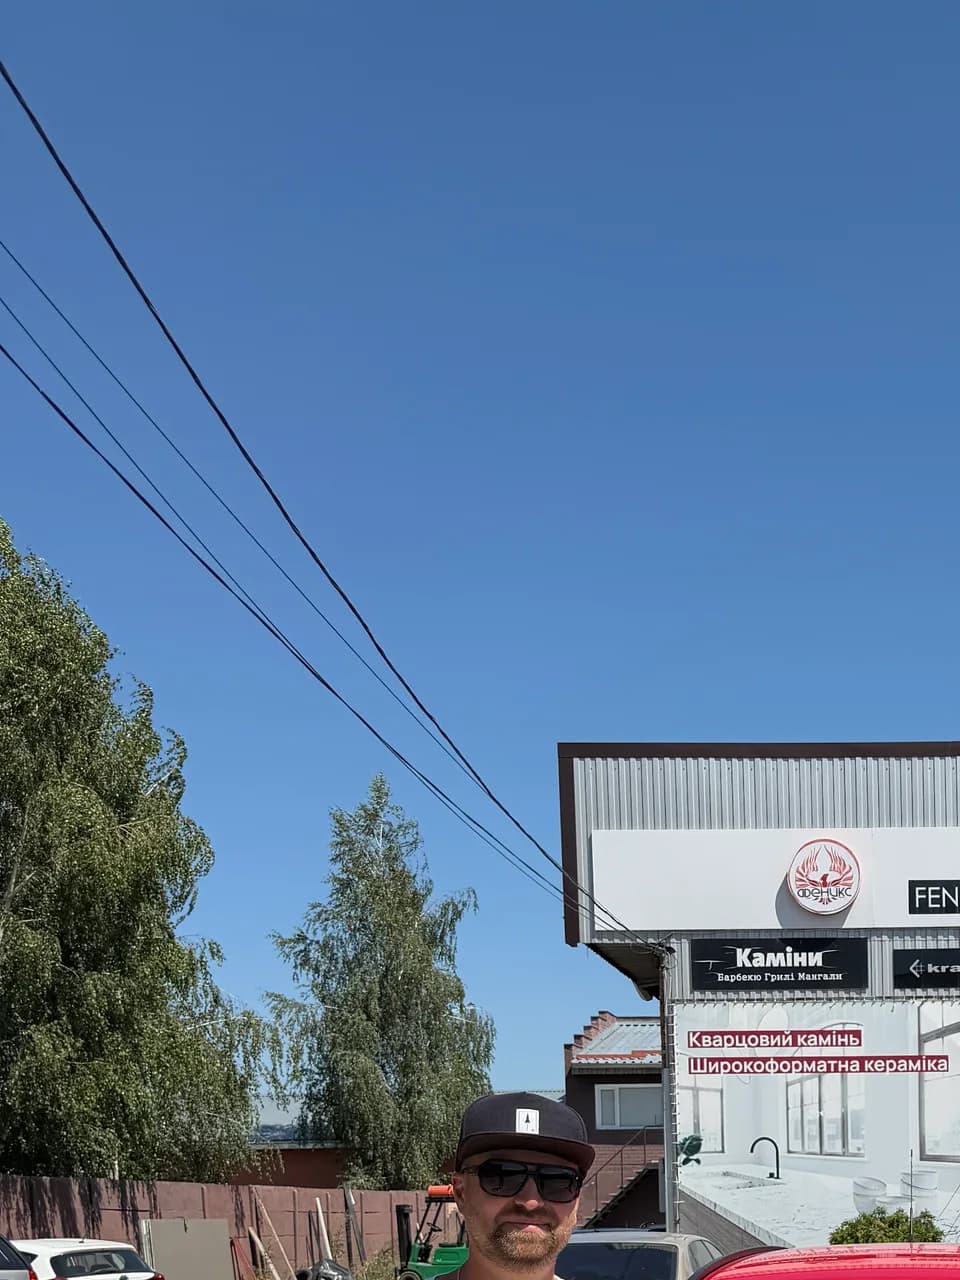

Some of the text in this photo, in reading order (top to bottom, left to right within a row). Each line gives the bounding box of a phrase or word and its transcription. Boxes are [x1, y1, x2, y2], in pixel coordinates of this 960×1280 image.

[735, 946, 823, 968] Каміни
[717, 972, 843, 982] Барбекю Грилі Мангали
[689, 1030, 861, 1049] Кварцовий камінь
[689, 1055, 948, 1076] Широкоформатна кераміка
